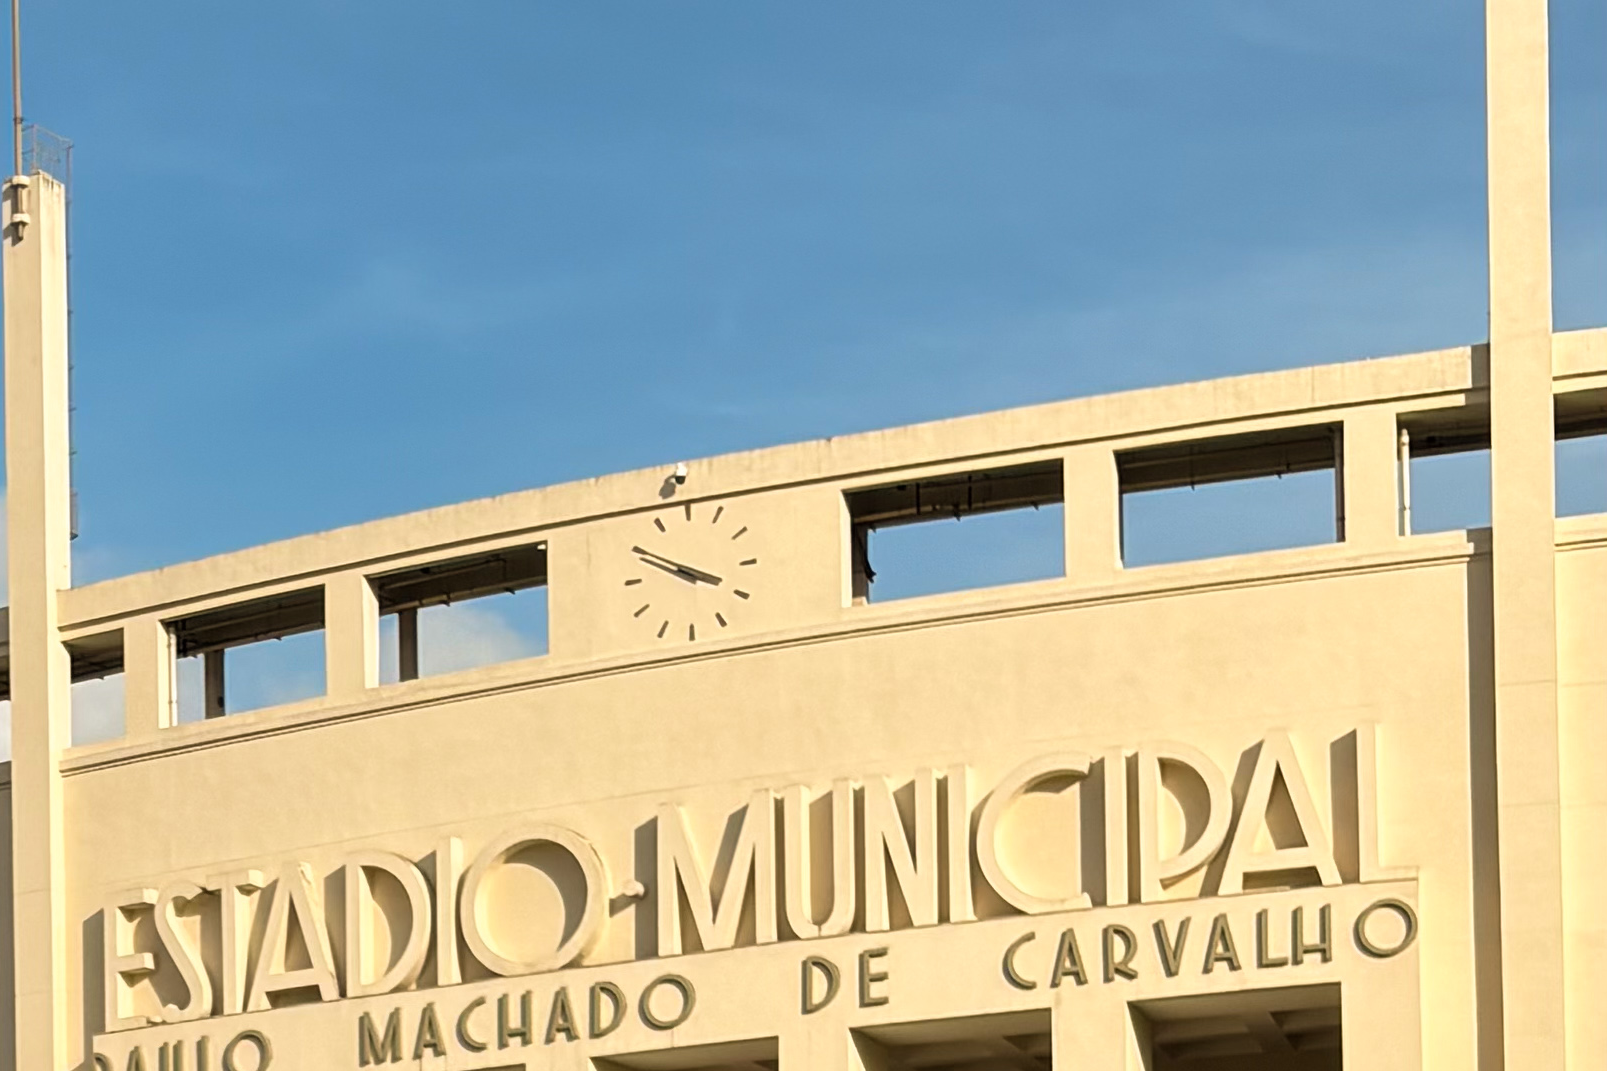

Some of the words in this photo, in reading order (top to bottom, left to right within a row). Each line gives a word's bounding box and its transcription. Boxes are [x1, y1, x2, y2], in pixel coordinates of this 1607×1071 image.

[656, 720, 1420, 958] MUNICIPAL
[357, 973, 697, 1068] MACHADO
[800, 945, 891, 1016] DE
[1007, 897, 1420, 991] CARVALHO
